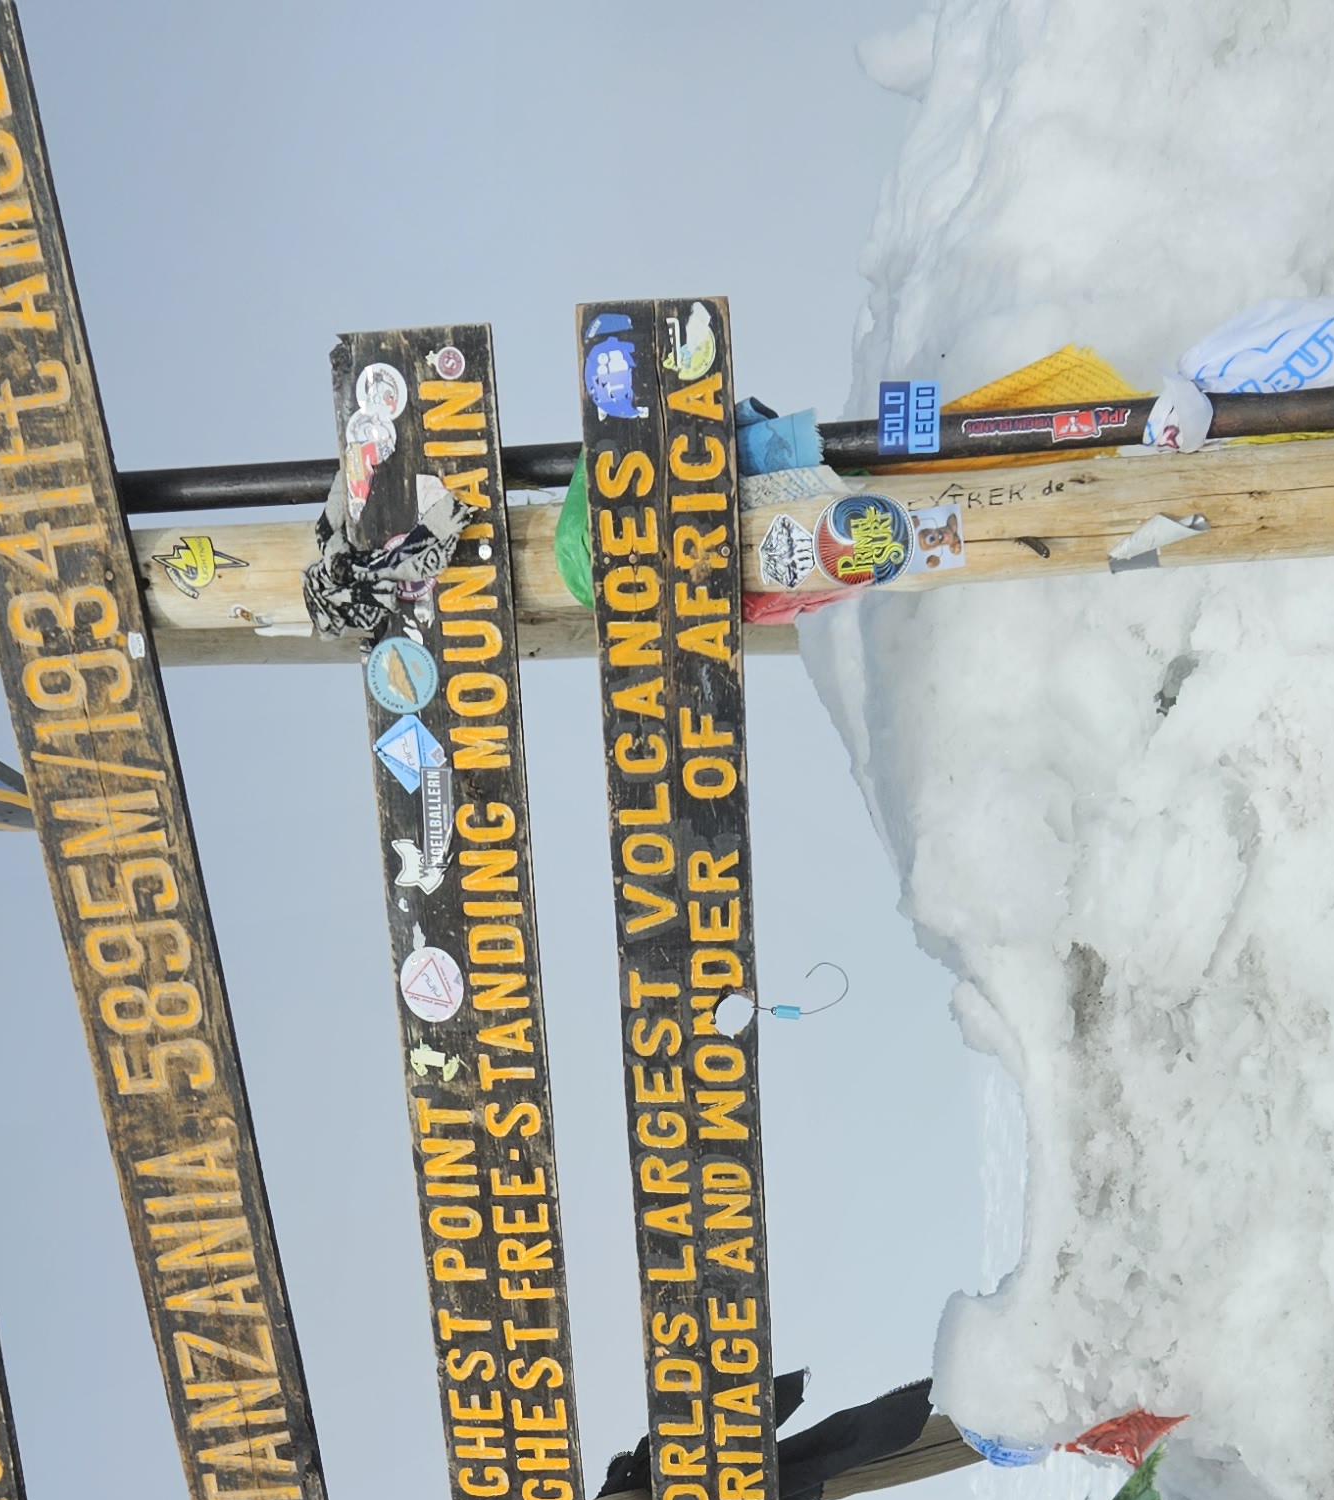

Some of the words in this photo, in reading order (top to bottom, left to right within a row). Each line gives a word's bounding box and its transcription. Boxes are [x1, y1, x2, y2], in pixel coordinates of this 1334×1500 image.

[884, 391, 905, 446] SOLO
[915, 386, 936, 448] LECCO
[1096, 407, 1129, 424] JPK
[666, 371, 732, 660] AFRICA
[872, 509, 905, 564] SURF
[595, 450, 678, 933] VOLCANOES
[679, 707, 737, 798] OF
[456, 802, 555, 1299] FREE-STANDING
[629, 971, 697, 1281] LARGEST
[418, 1096, 486, 1281] POINT
[702, 1160, 755, 1273] AND
